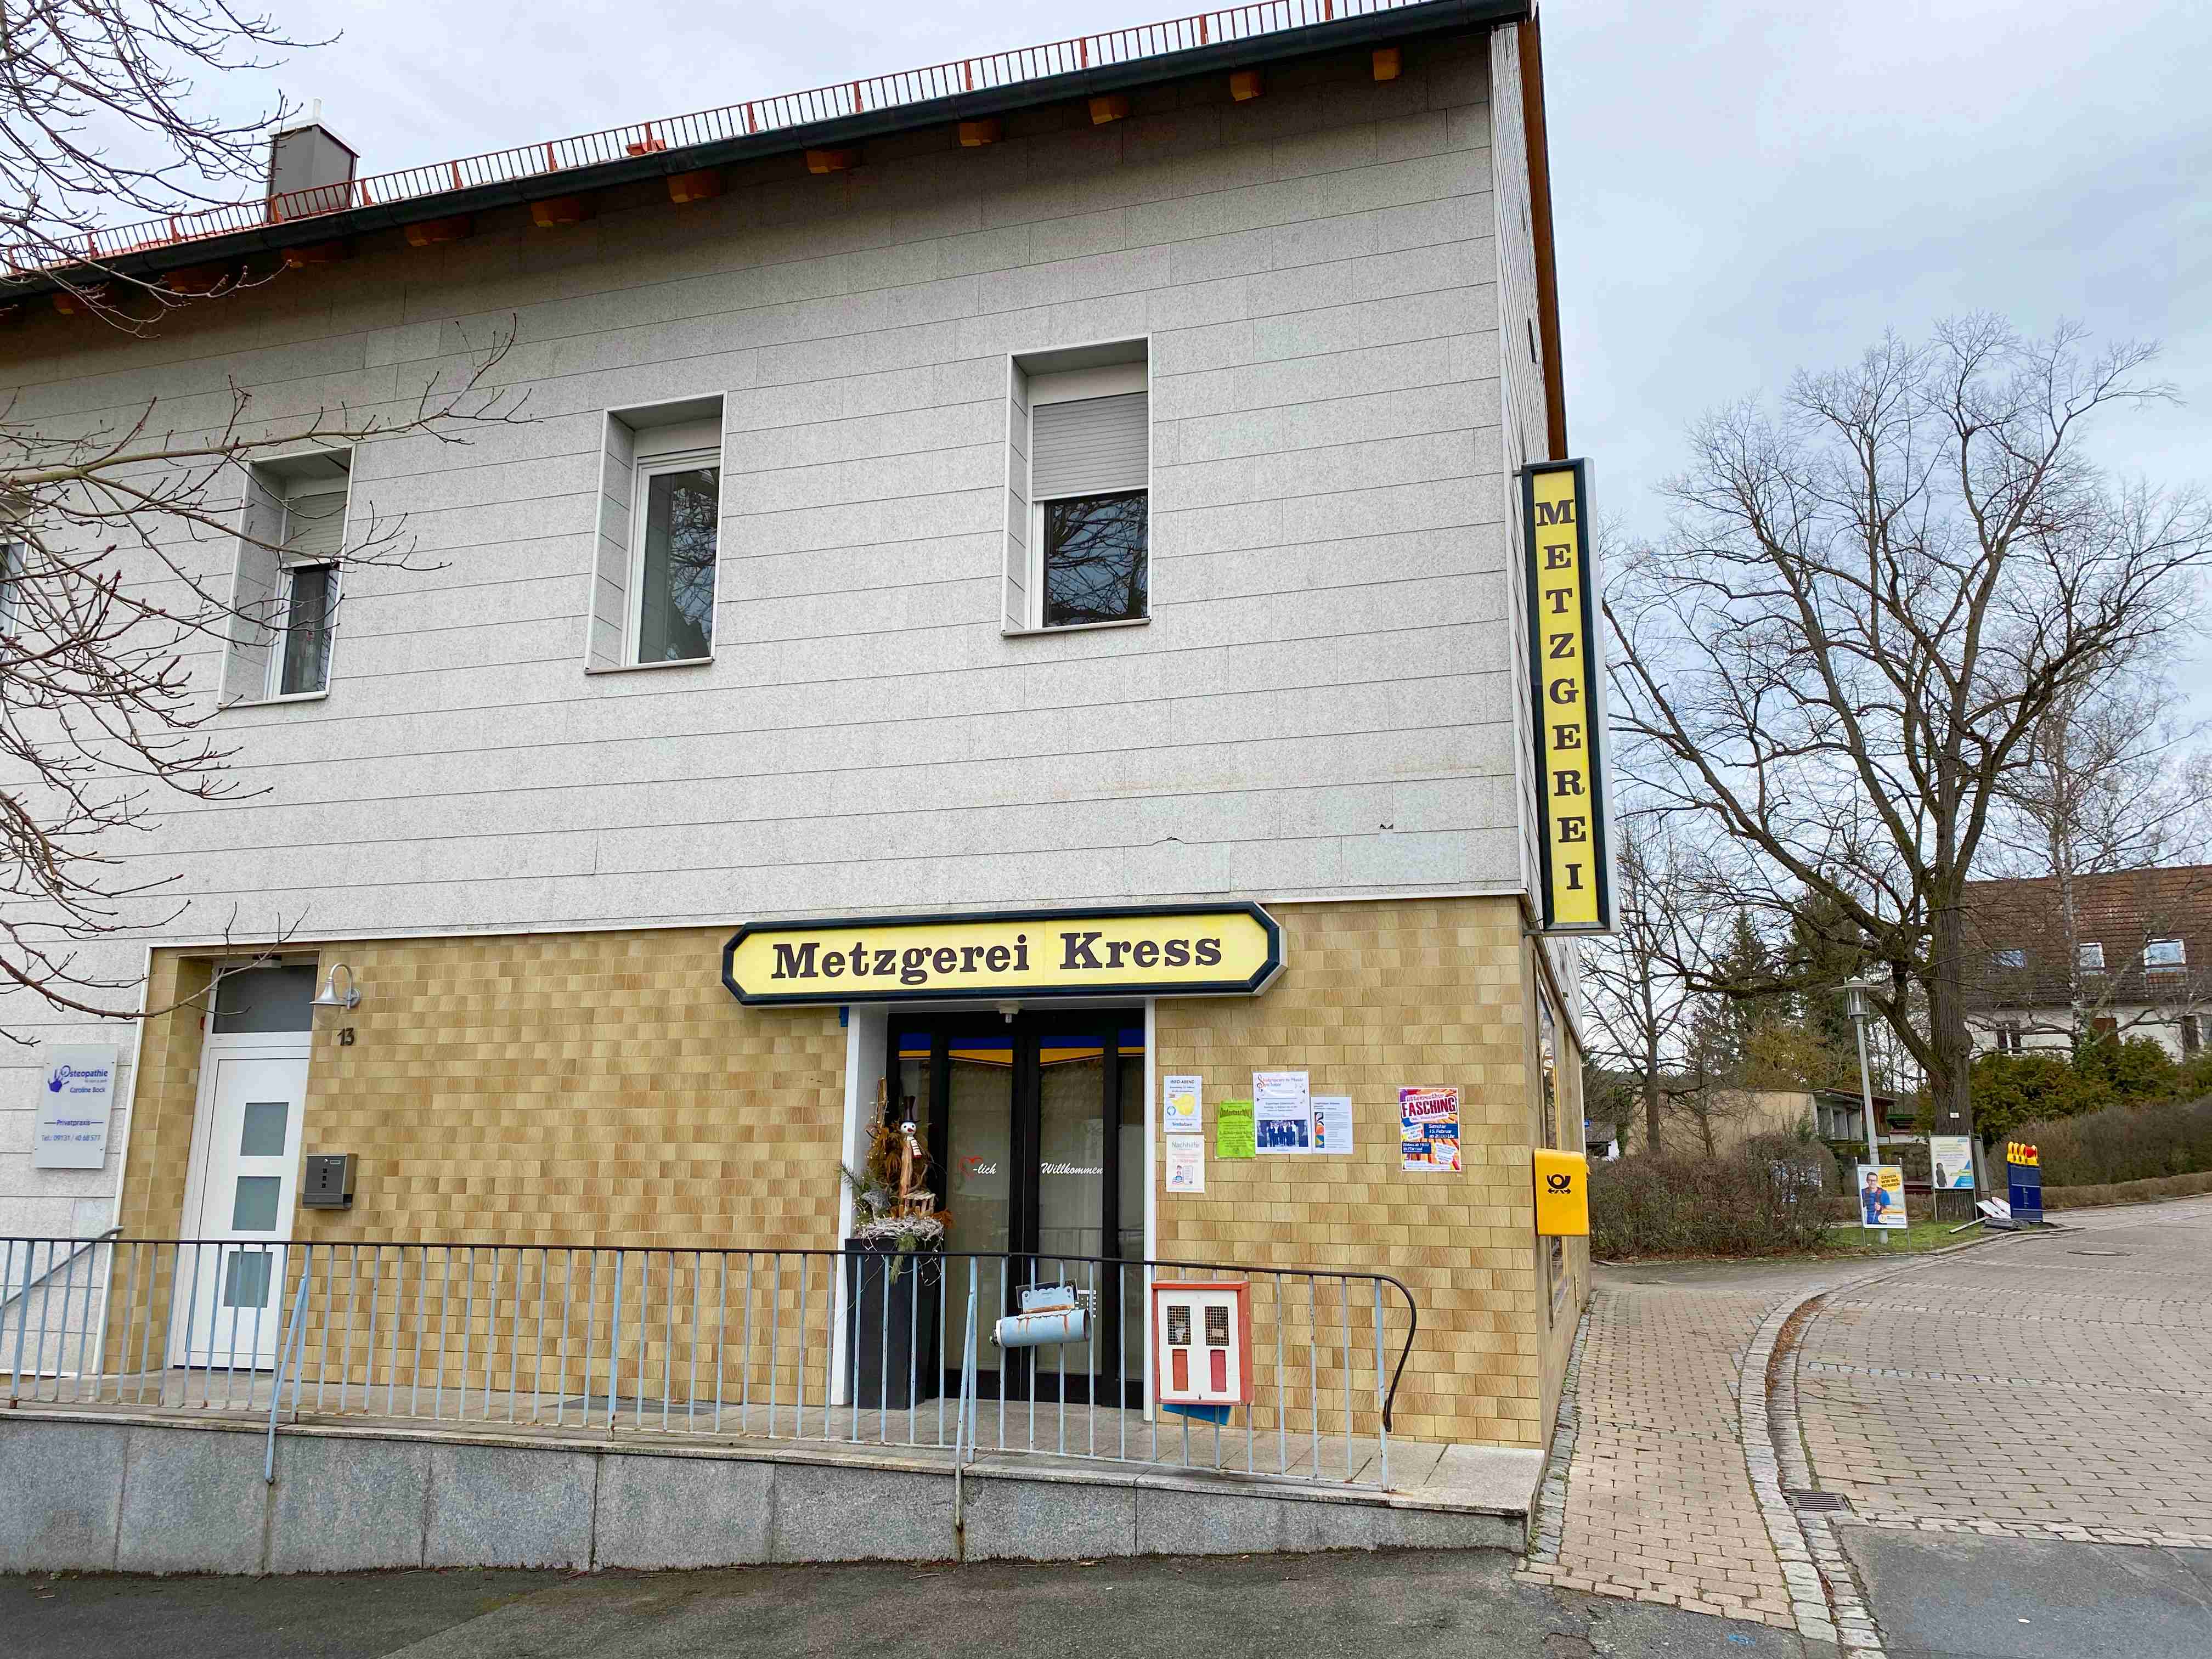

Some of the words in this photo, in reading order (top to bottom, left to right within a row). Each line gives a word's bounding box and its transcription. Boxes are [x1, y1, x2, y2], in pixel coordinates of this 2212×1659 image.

[1536, 499, 1587, 890] METZGEREI
[771, 934, 1030, 985] Metzgerei
[1059, 932, 1222, 969] Kress
[337, 1027, 354, 1046] 13
[61, 1065, 108, 1078] Osteopathie
[1402, 1097, 1456, 1118] FASCHING
[973, 1163, 997, 1175] -lich
[1041, 1162, 1103, 1175] Willkommen
